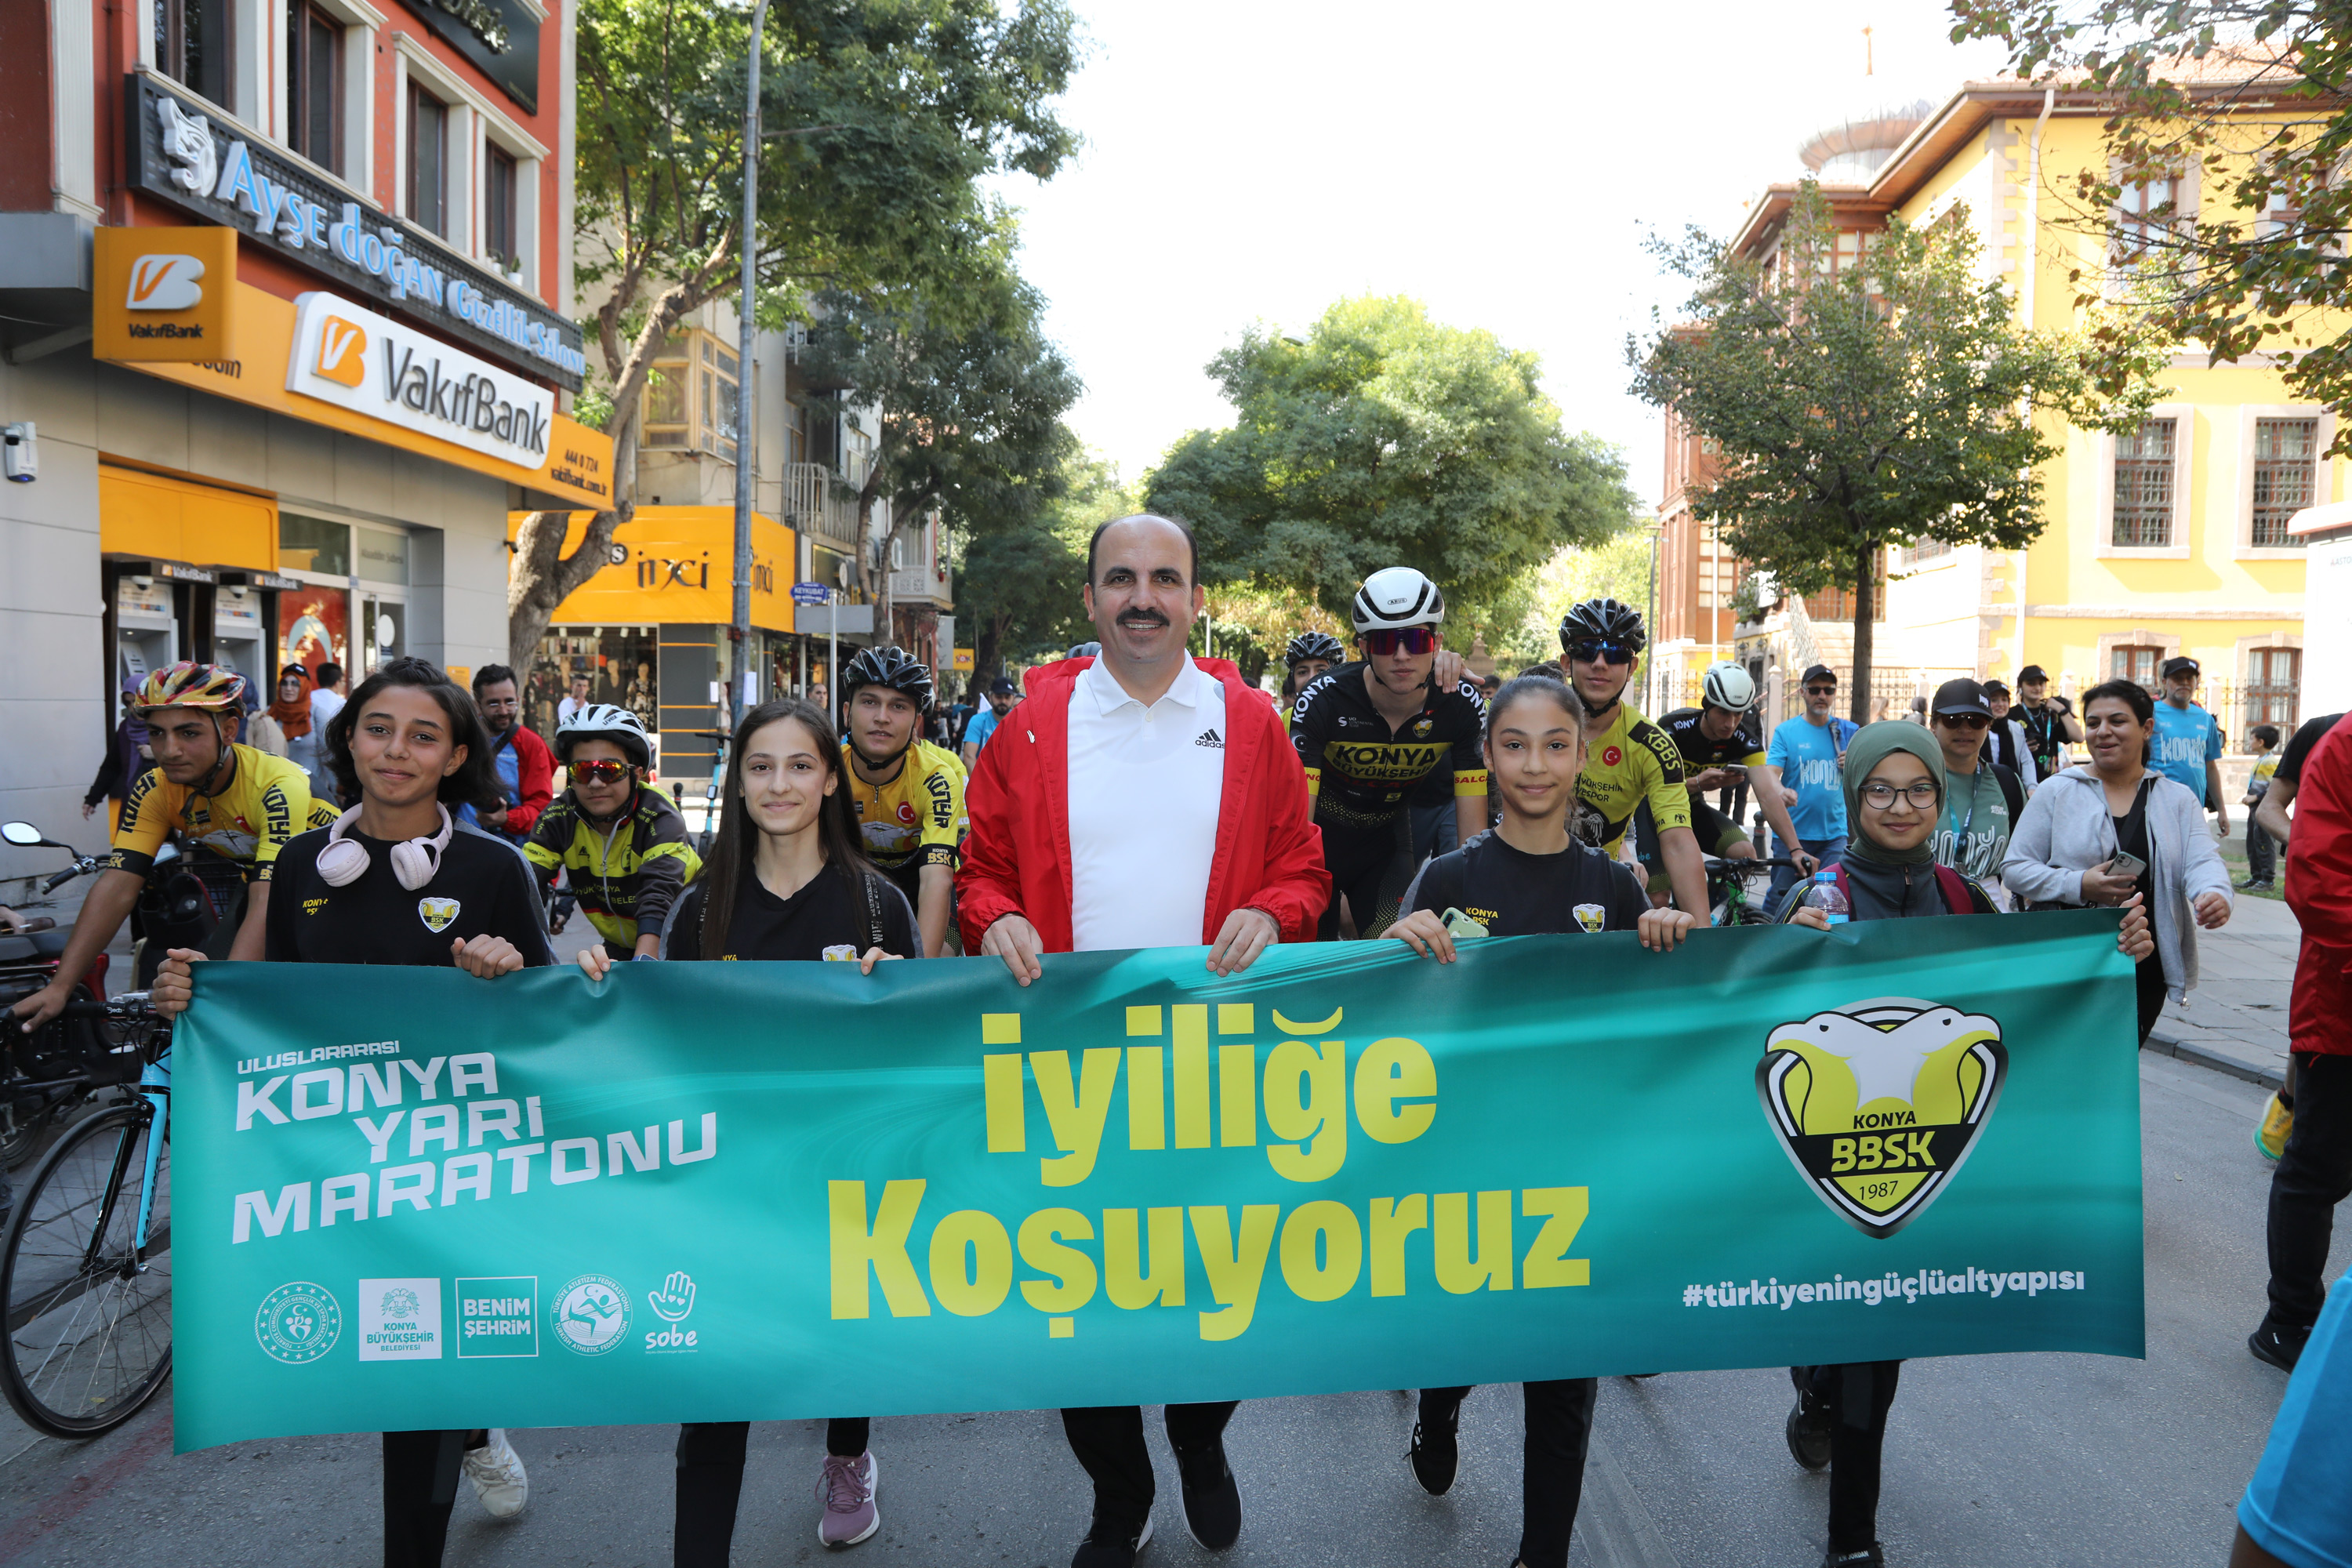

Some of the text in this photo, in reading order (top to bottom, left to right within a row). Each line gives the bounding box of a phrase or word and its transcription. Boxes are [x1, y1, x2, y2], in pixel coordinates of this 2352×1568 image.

[129, 323, 204, 338] VakıfBank
[380, 336, 547, 455] VakıfBank
[565, 449, 578, 466] 444
[1292, 675, 1337, 723] KONYA
[602, 714, 617, 726] uvex
[1337, 746, 1436, 767] KONYA
[1642, 728, 1681, 771] KBBS
[927, 852, 951, 866] BSK
[1465, 907, 1498, 918] KONYA
[238, 1040, 401, 1075] ULUSLARARASI
[236, 1052, 499, 1132] KONYA
[982, 1003, 1437, 1187] iyiliğe
[353, 1095, 544, 1164] YARI
[1853, 1111, 1916, 1129] KONYA
[1831, 1131, 1936, 1172] BBSK
[232, 1112, 717, 1245] MARATONU
[1860, 1181, 1898, 1200] 1987
[827, 1178, 1591, 1341] Koşuyoruz
[552, 1275, 630, 1313] TÜRKİYE ATLETİZM FEDERASYONU
[1682, 1267, 2085, 1310] #türkiyeningüçlüaltyapısı
[366, 1332, 434, 1344] BÜYÜKŞEHİR
[383, 1322, 417, 1331] KONYA
[554, 1320, 629, 1353] TURKISH ATHLETIC FEDERATION
[644, 1323, 699, 1350] sobe
[1849, 1549, 1869, 1560] JORDAN
